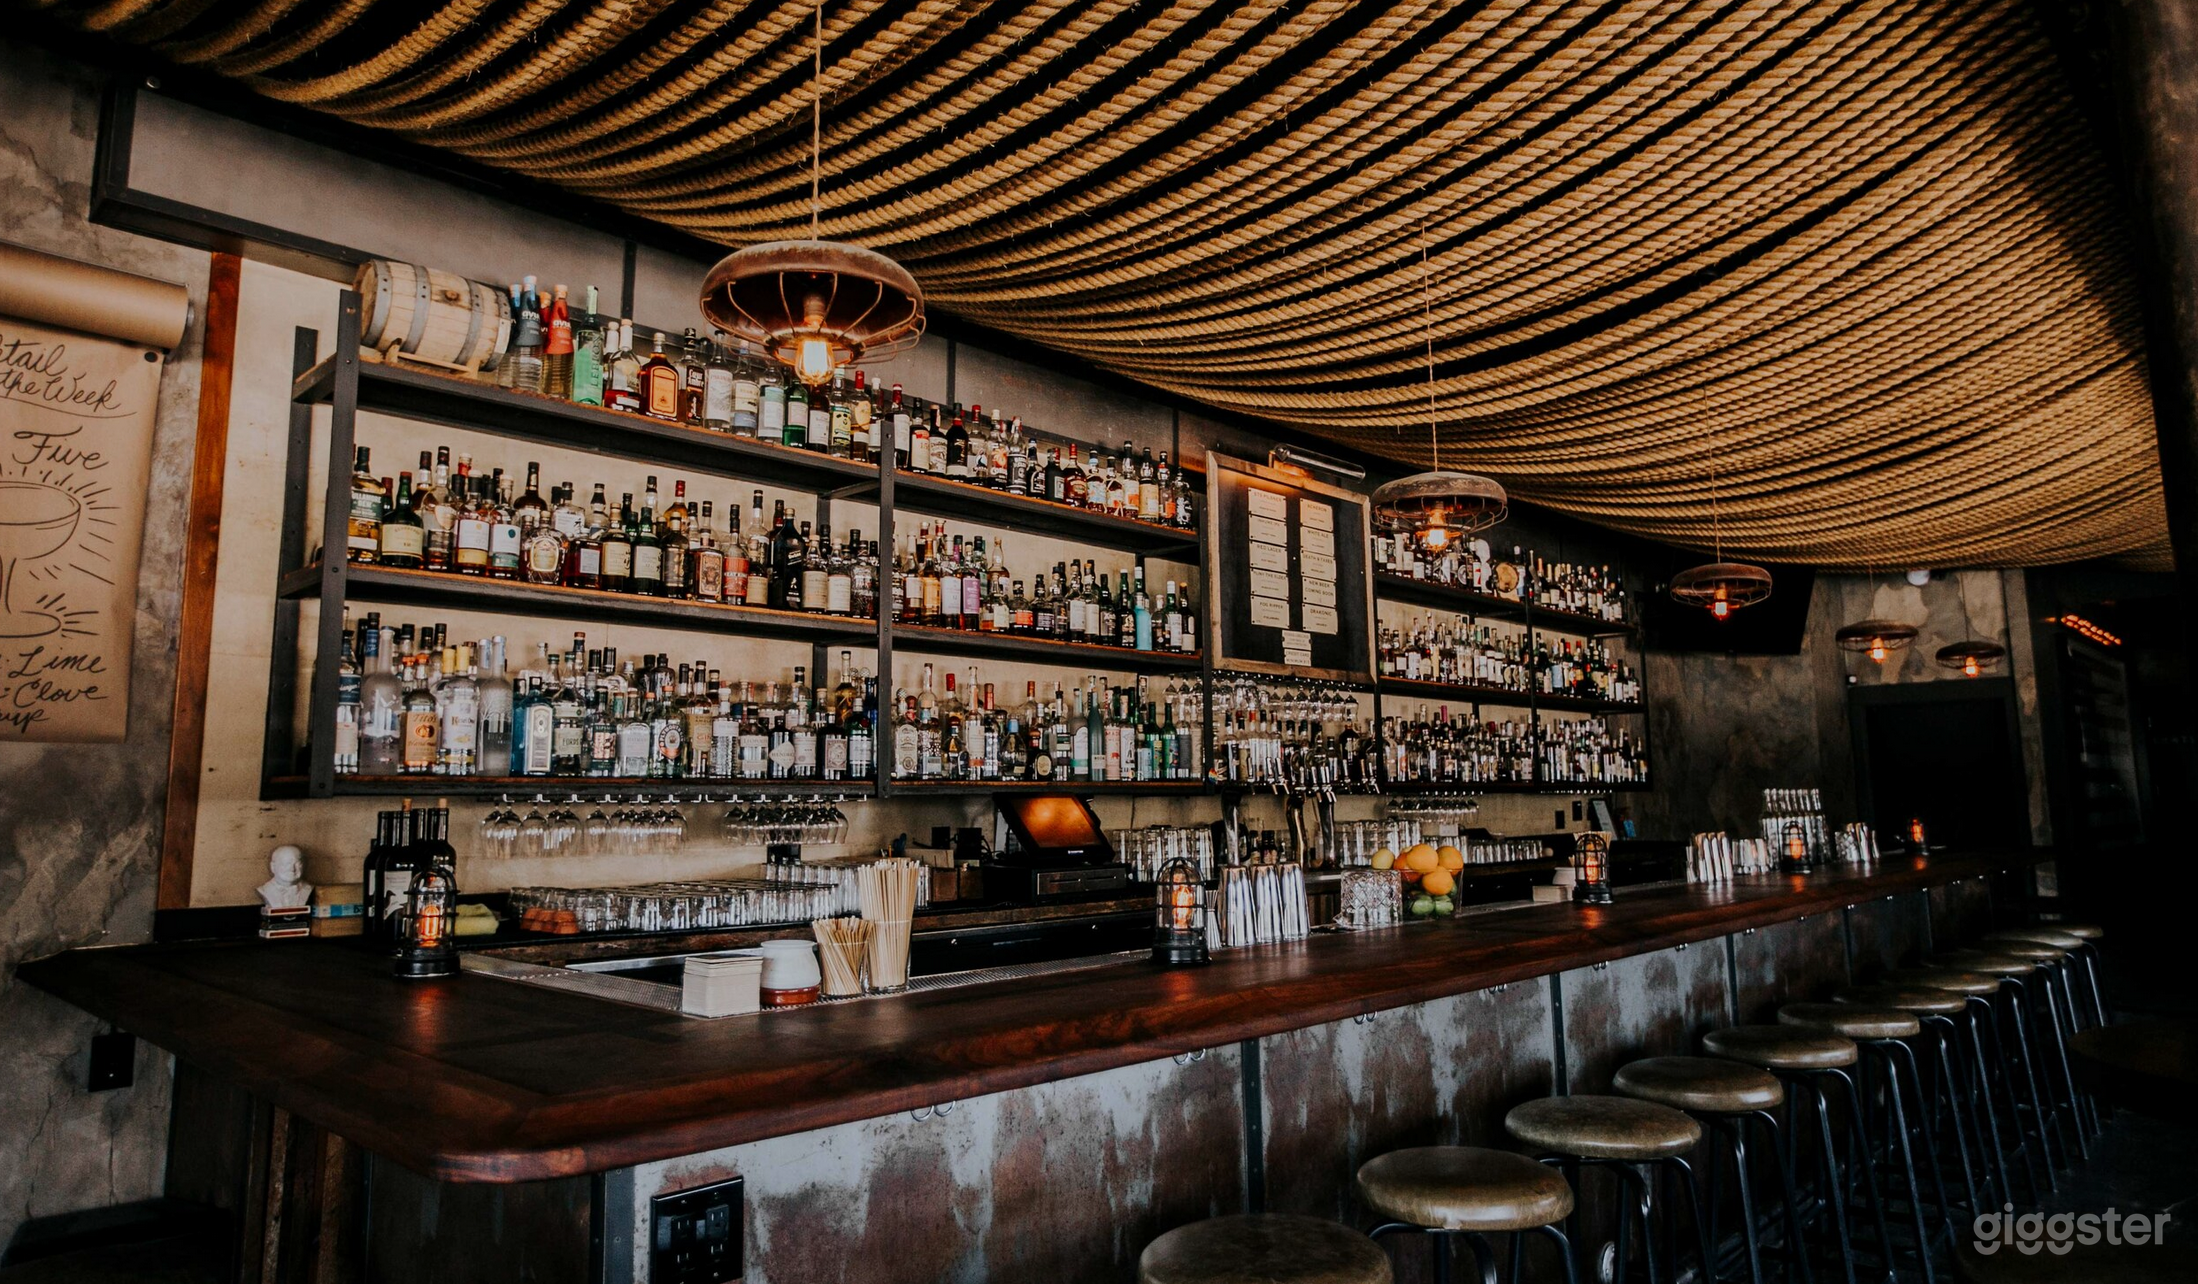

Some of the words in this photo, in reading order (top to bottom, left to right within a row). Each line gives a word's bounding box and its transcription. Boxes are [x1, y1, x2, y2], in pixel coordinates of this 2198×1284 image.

[0, 333, 68, 377] tail
[43, 372, 122, 413] Week
[12, 425, 109, 470] Five
[8, 645, 107, 679] Lime
[13, 678, 108, 709] Clove
